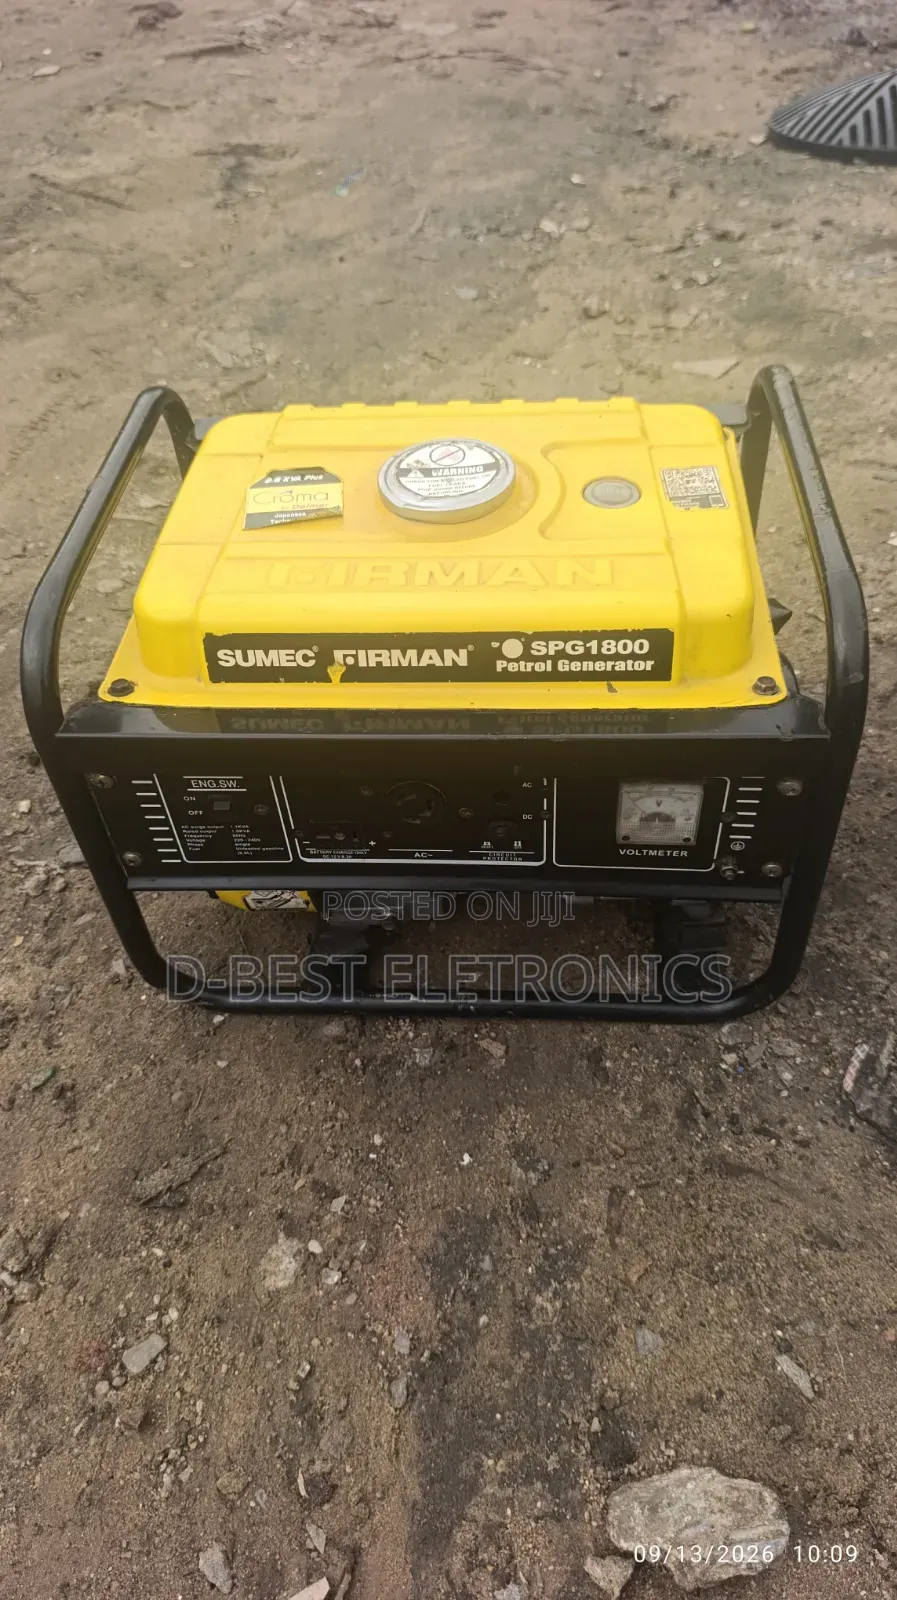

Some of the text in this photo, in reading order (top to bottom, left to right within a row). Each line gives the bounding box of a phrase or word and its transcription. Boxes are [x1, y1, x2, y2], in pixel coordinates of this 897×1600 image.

[431, 466, 484, 477] WARNING
[253, 490, 329, 505] Croma
[530, 638, 650, 656] SPG1800
[496, 658, 655, 673] Petrol Generator
[190, 779, 240, 789] ENG.SW.
[618, 848, 689, 858] VOLTMETER
